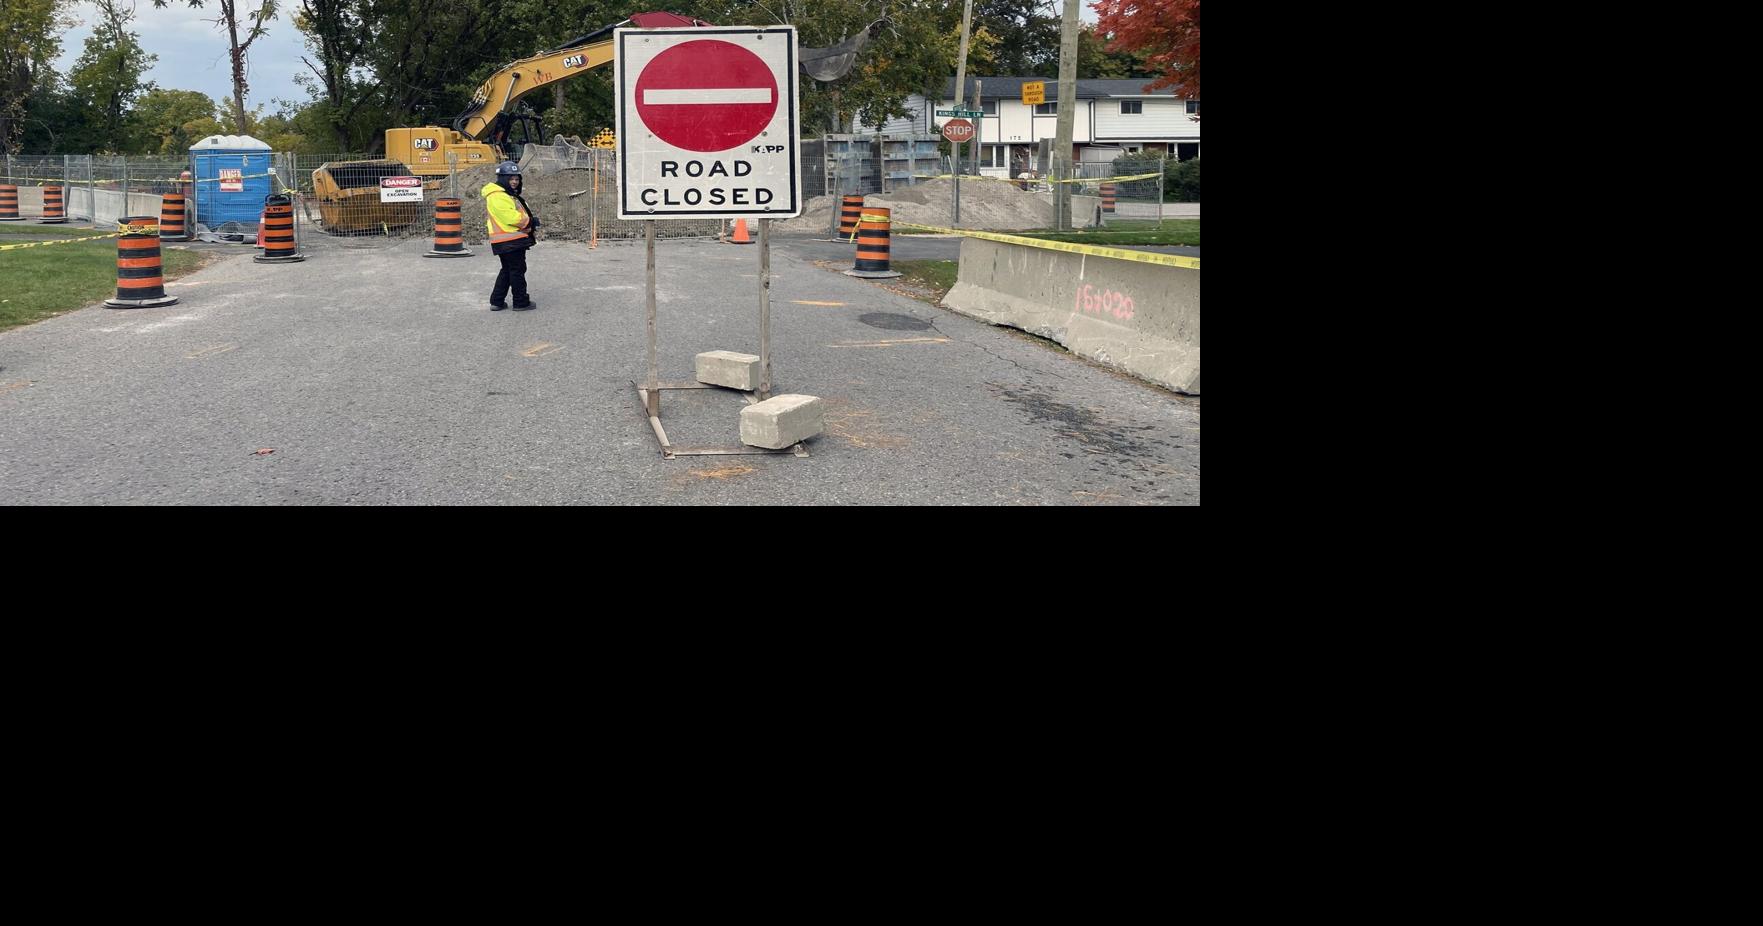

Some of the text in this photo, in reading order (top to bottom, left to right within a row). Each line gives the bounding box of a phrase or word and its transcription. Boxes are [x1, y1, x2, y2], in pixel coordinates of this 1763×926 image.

[563, 55, 582, 68] CAT
[946, 126, 972, 136] STOP
[414, 138, 433, 149] CAT
[661, 160, 752, 177] ROAD
[640, 188, 774, 206] CLOSED
